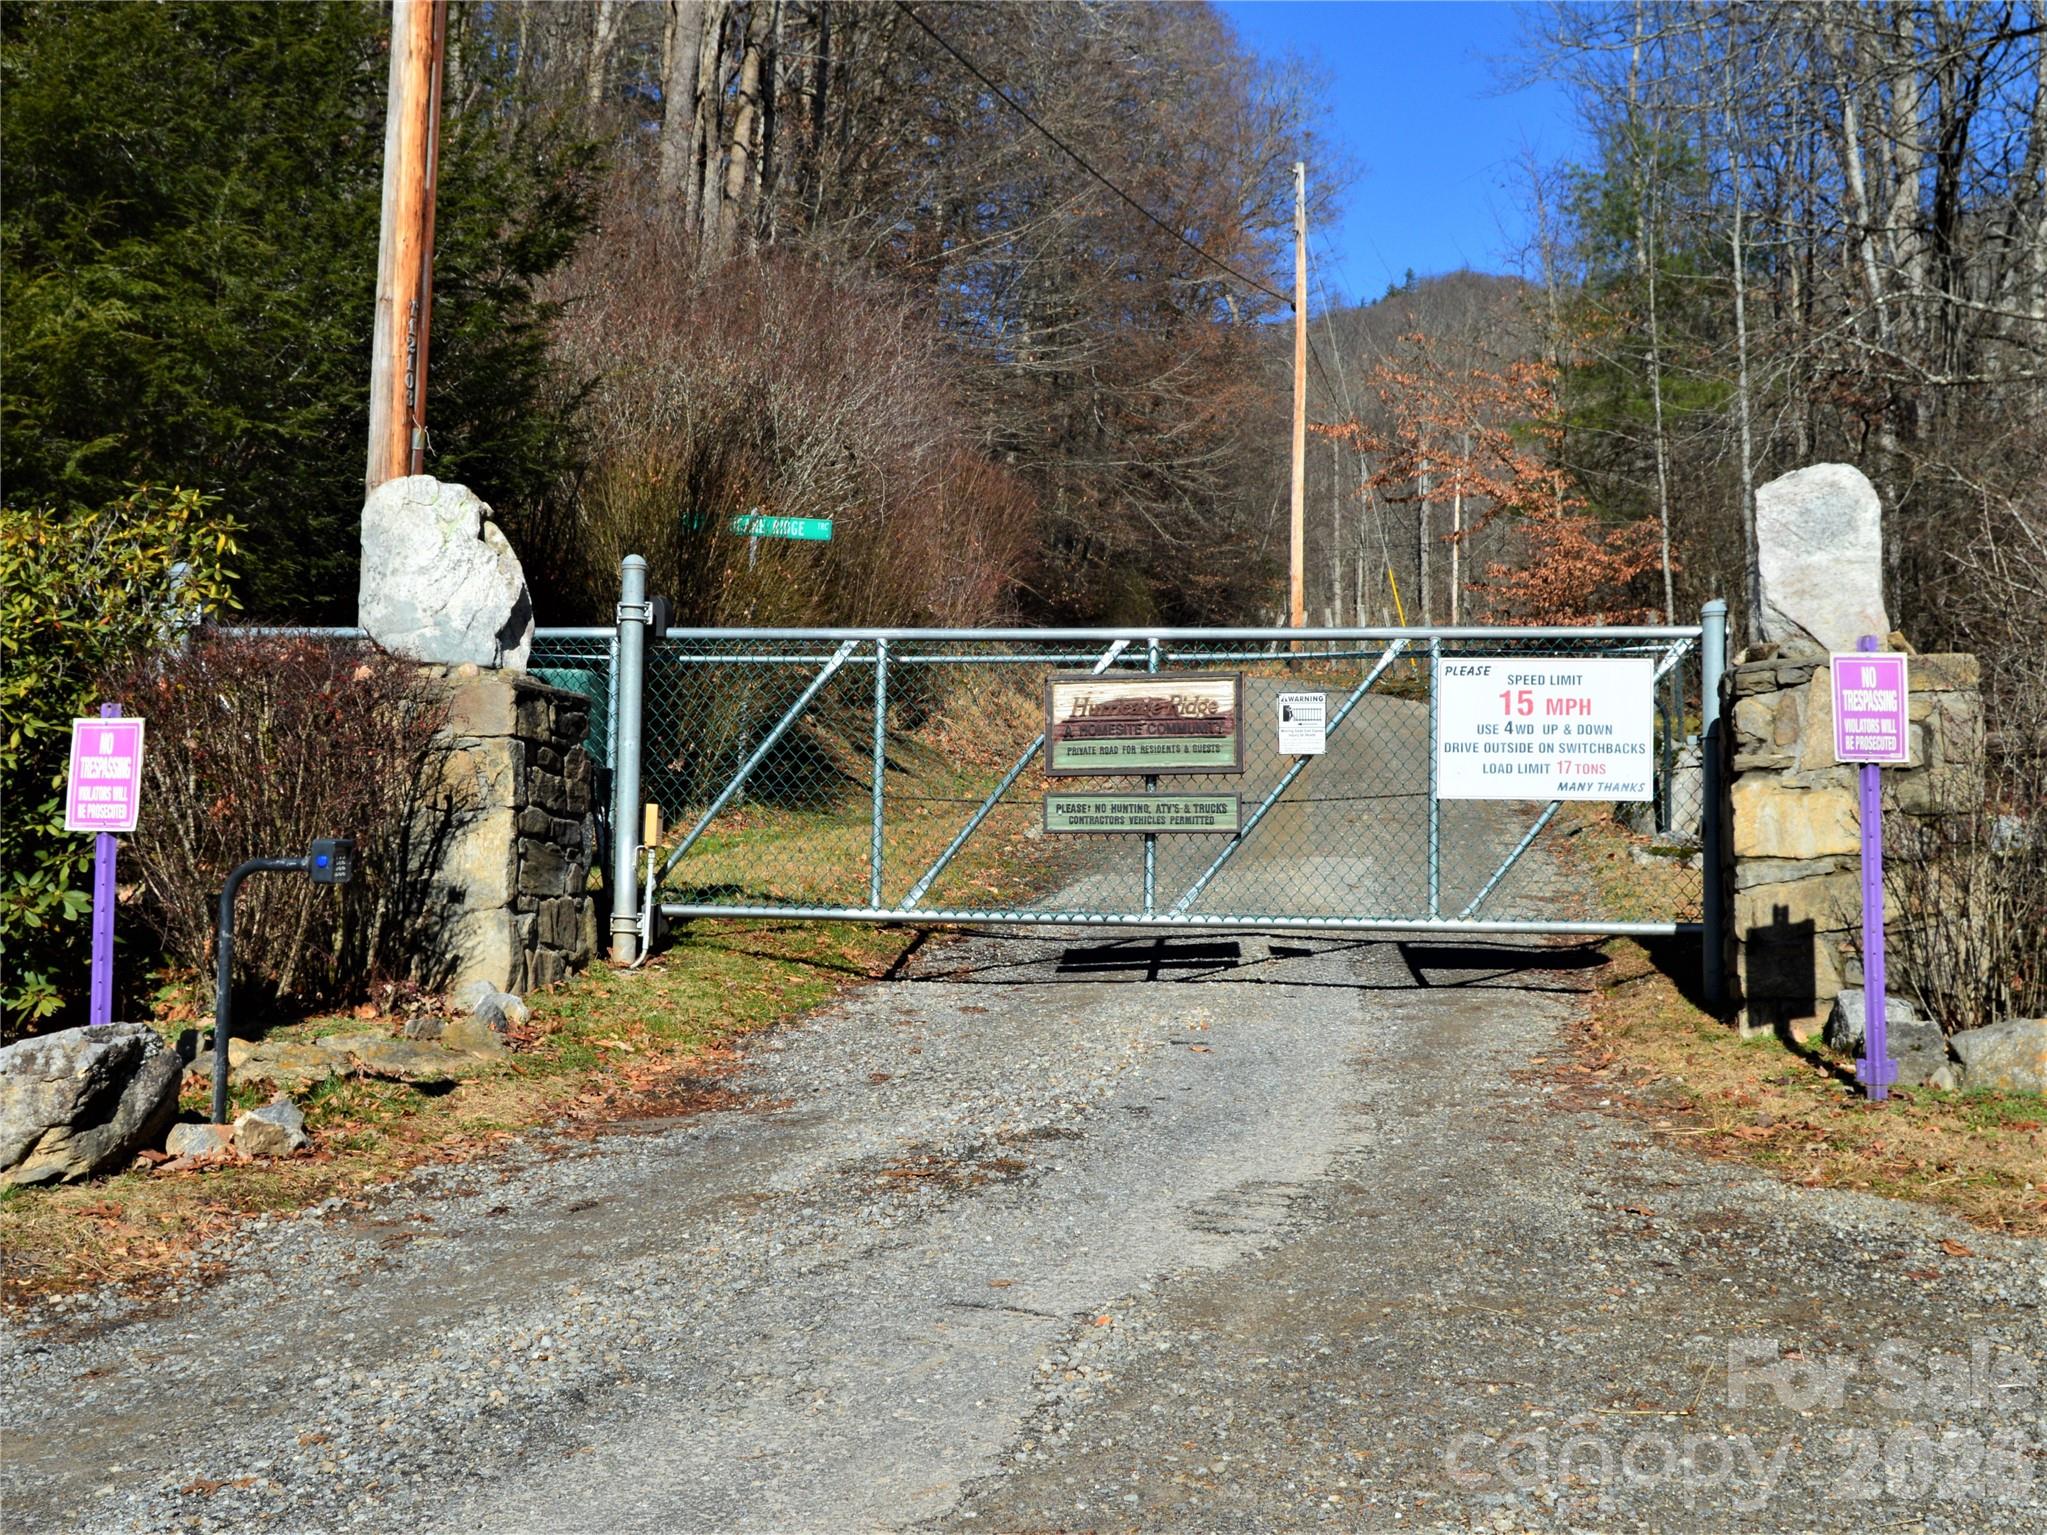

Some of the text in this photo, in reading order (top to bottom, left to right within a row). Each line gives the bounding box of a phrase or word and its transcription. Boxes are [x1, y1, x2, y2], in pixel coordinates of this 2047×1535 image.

[1444, 665, 1492, 676] PLEASE
[1861, 666, 1877, 689] NO
[1507, 674, 1583, 686] SPEED LIMIT
[1167, 694, 1219, 718] Ridge
[1499, 690, 1591, 716] 15 MPH
[1842, 689, 1898, 712] TRESPASSING
[1063, 723, 1073, 738] A
[1080, 723, 1142, 737] HOMESITE
[1477, 724, 1500, 735] USE
[1543, 724, 1559, 735] UP
[1563, 724, 1572, 735] &
[1577, 724, 1613, 735] DOWN
[1844, 718, 1896, 734] VIOLATORS WILL
[98, 732, 114, 755] NO
[1067, 746, 1097, 756] PRIVATE
[1099, 746, 1119, 755] ROAD
[1122, 745, 1137, 755] FOR
[1140, 744, 1181, 754] RESIDENTS
[1192, 744, 1221, 754] GUESTS
[1444, 742, 1646, 754] DRIVE OUTSIDE ON SWITCHBACKS
[1845, 735, 1897, 751] BE PROSECUTED
[79, 756, 132, 779] TRESPASSING
[1482, 760, 1607, 774] LOAD LIMIT 17 TONS
[78, 785, 128, 801] VIOLATORS WILL
[1557, 782, 1646, 792] MANY THANKS
[77, 803, 128, 819] BE PROSECUTED
[1056, 803, 1091, 814] PLEASE:
[1095, 803, 1107, 813] NO
[1155, 803, 1180, 813] ATV'S
[1184, 803, 1191, 813] &
[1193, 803, 1228, 814] TRUCKS
[1068, 815, 1215, 825] CONTRACTORS VEHICLES PERMITTED
